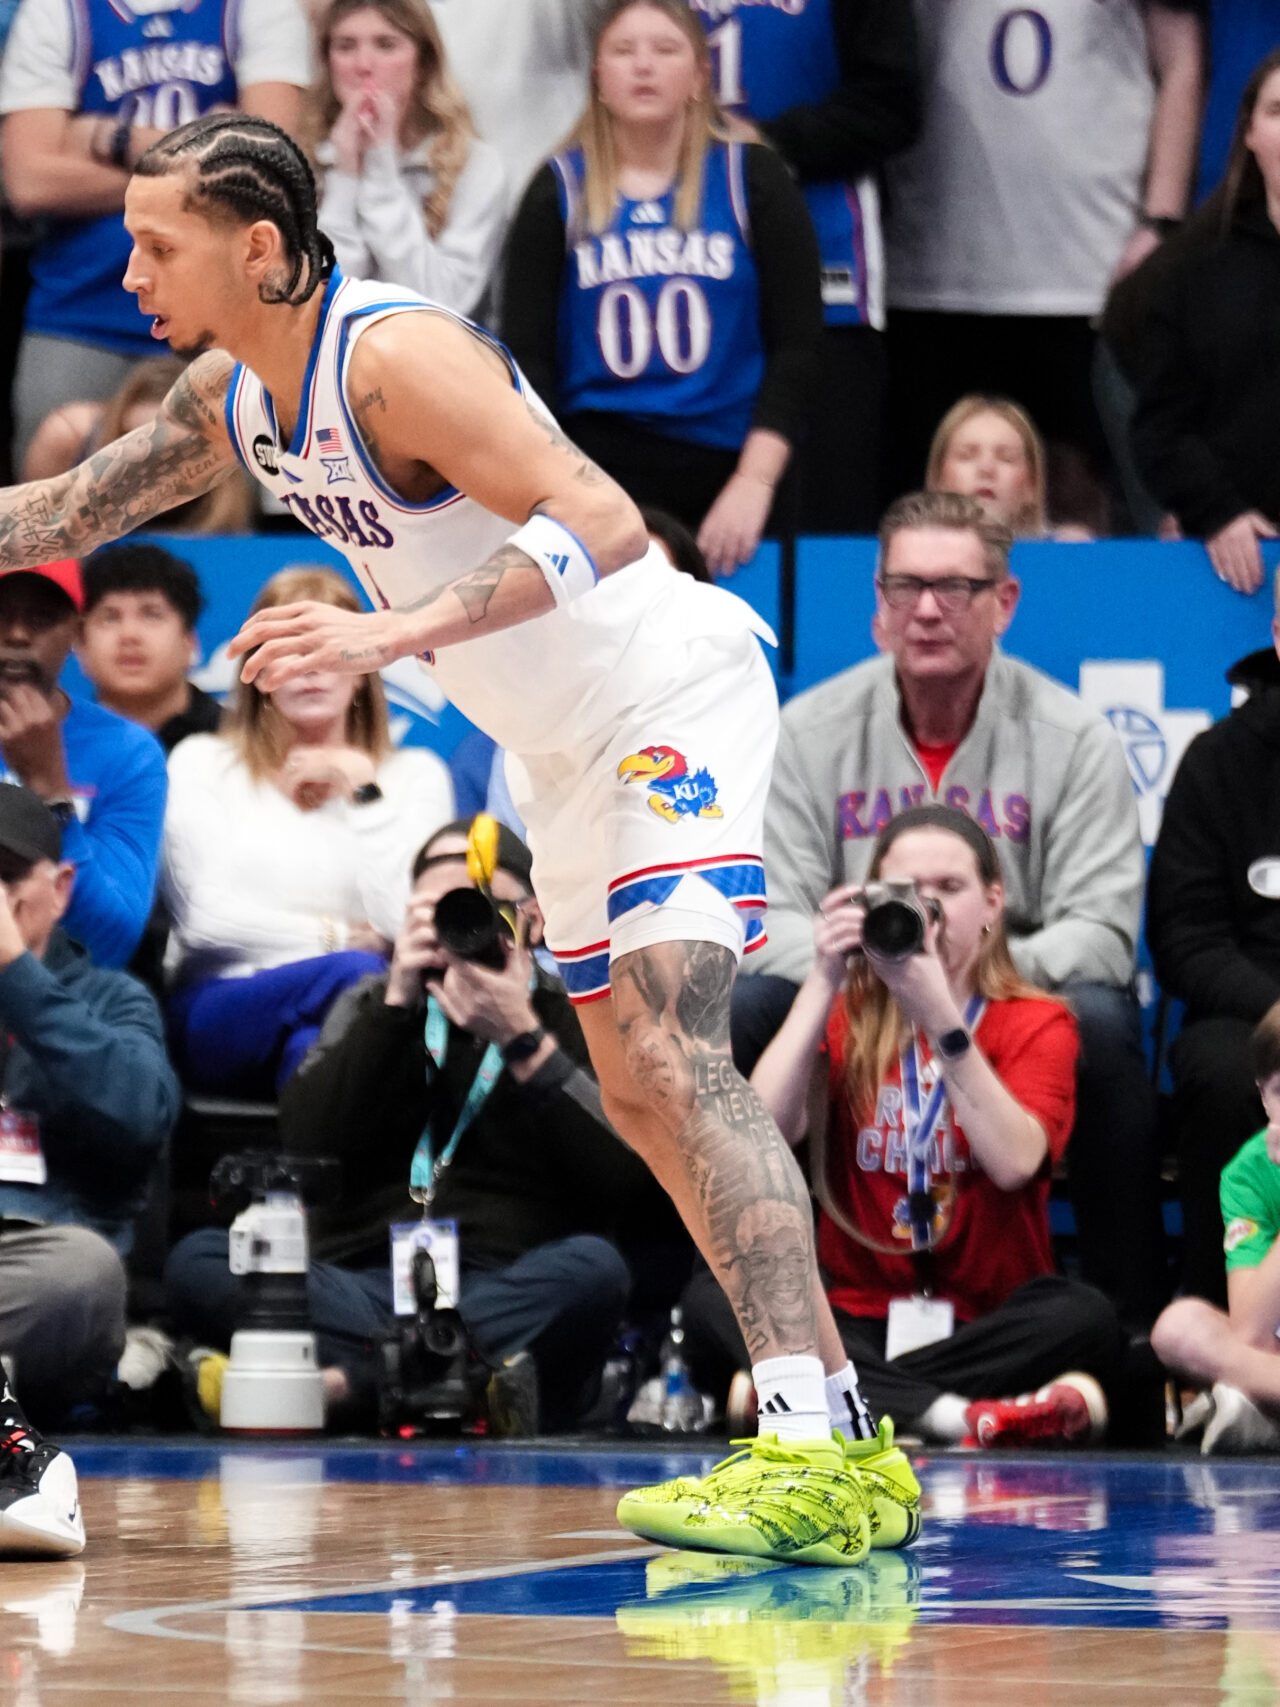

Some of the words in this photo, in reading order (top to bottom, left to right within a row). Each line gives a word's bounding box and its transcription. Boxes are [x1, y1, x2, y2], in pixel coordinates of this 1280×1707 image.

[94, 42, 223, 102] KANSAS
[987, 8, 1052, 97] 0
[574, 226, 735, 290] KANSAS
[597, 275, 711, 379] 00
[673, 782, 700, 801] KU
